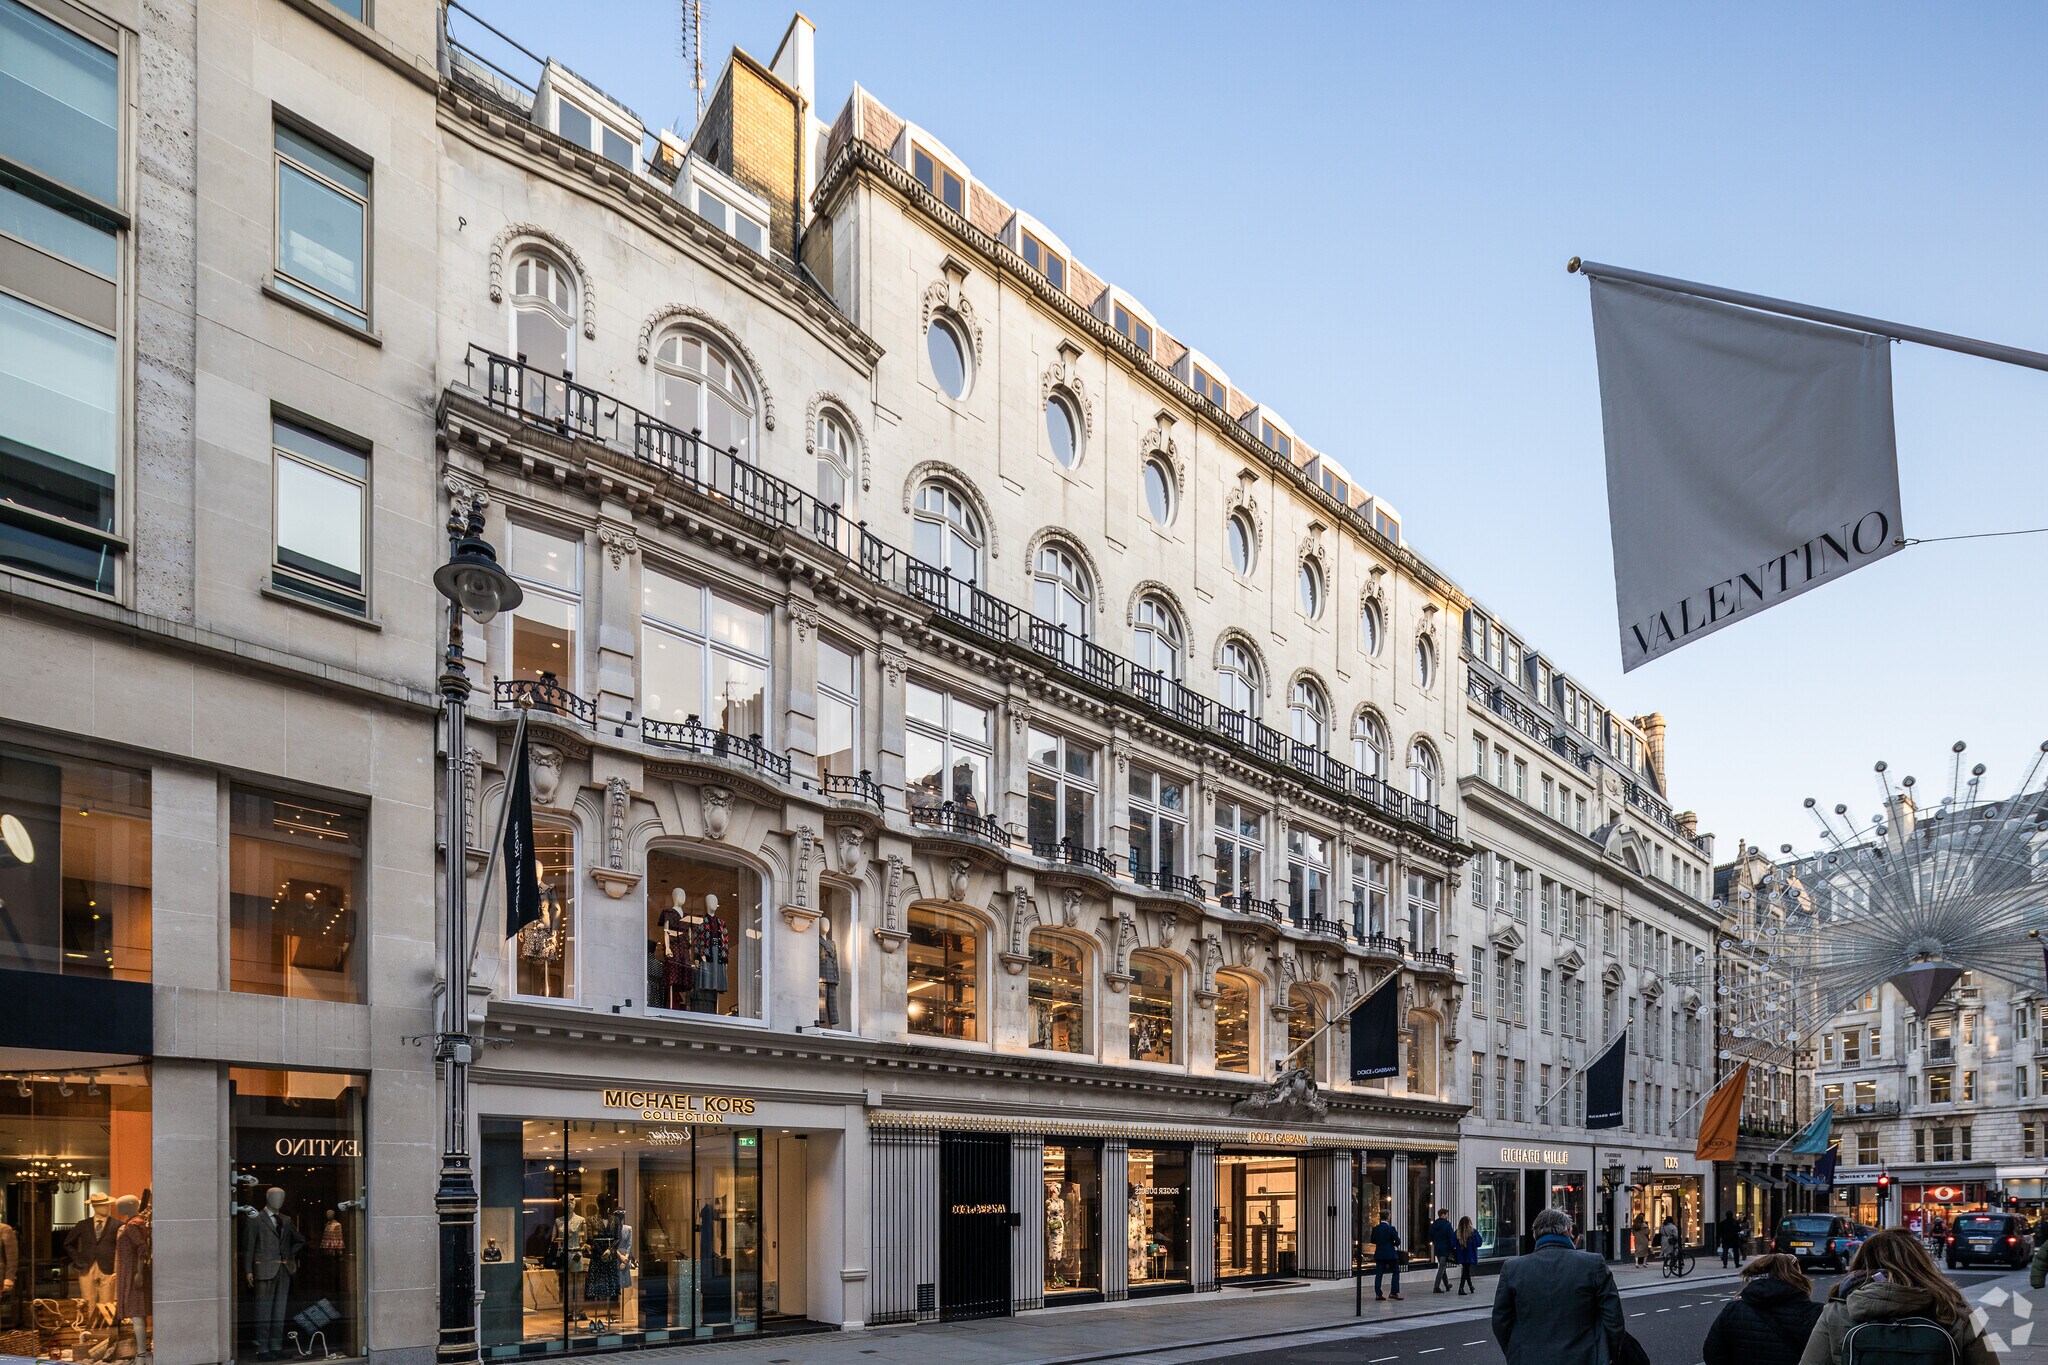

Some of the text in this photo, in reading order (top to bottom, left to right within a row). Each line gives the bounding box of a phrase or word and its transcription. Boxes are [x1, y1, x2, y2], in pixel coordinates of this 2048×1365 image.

[1629, 511, 1889, 655] VALENTINO
[604, 1090, 756, 1115] MICHAEL KORS
[642, 1110, 724, 1123] COLLECTION
[455, 1160, 462, 1168] 3
[1501, 1148, 1569, 1165] RICHARD MILLE
